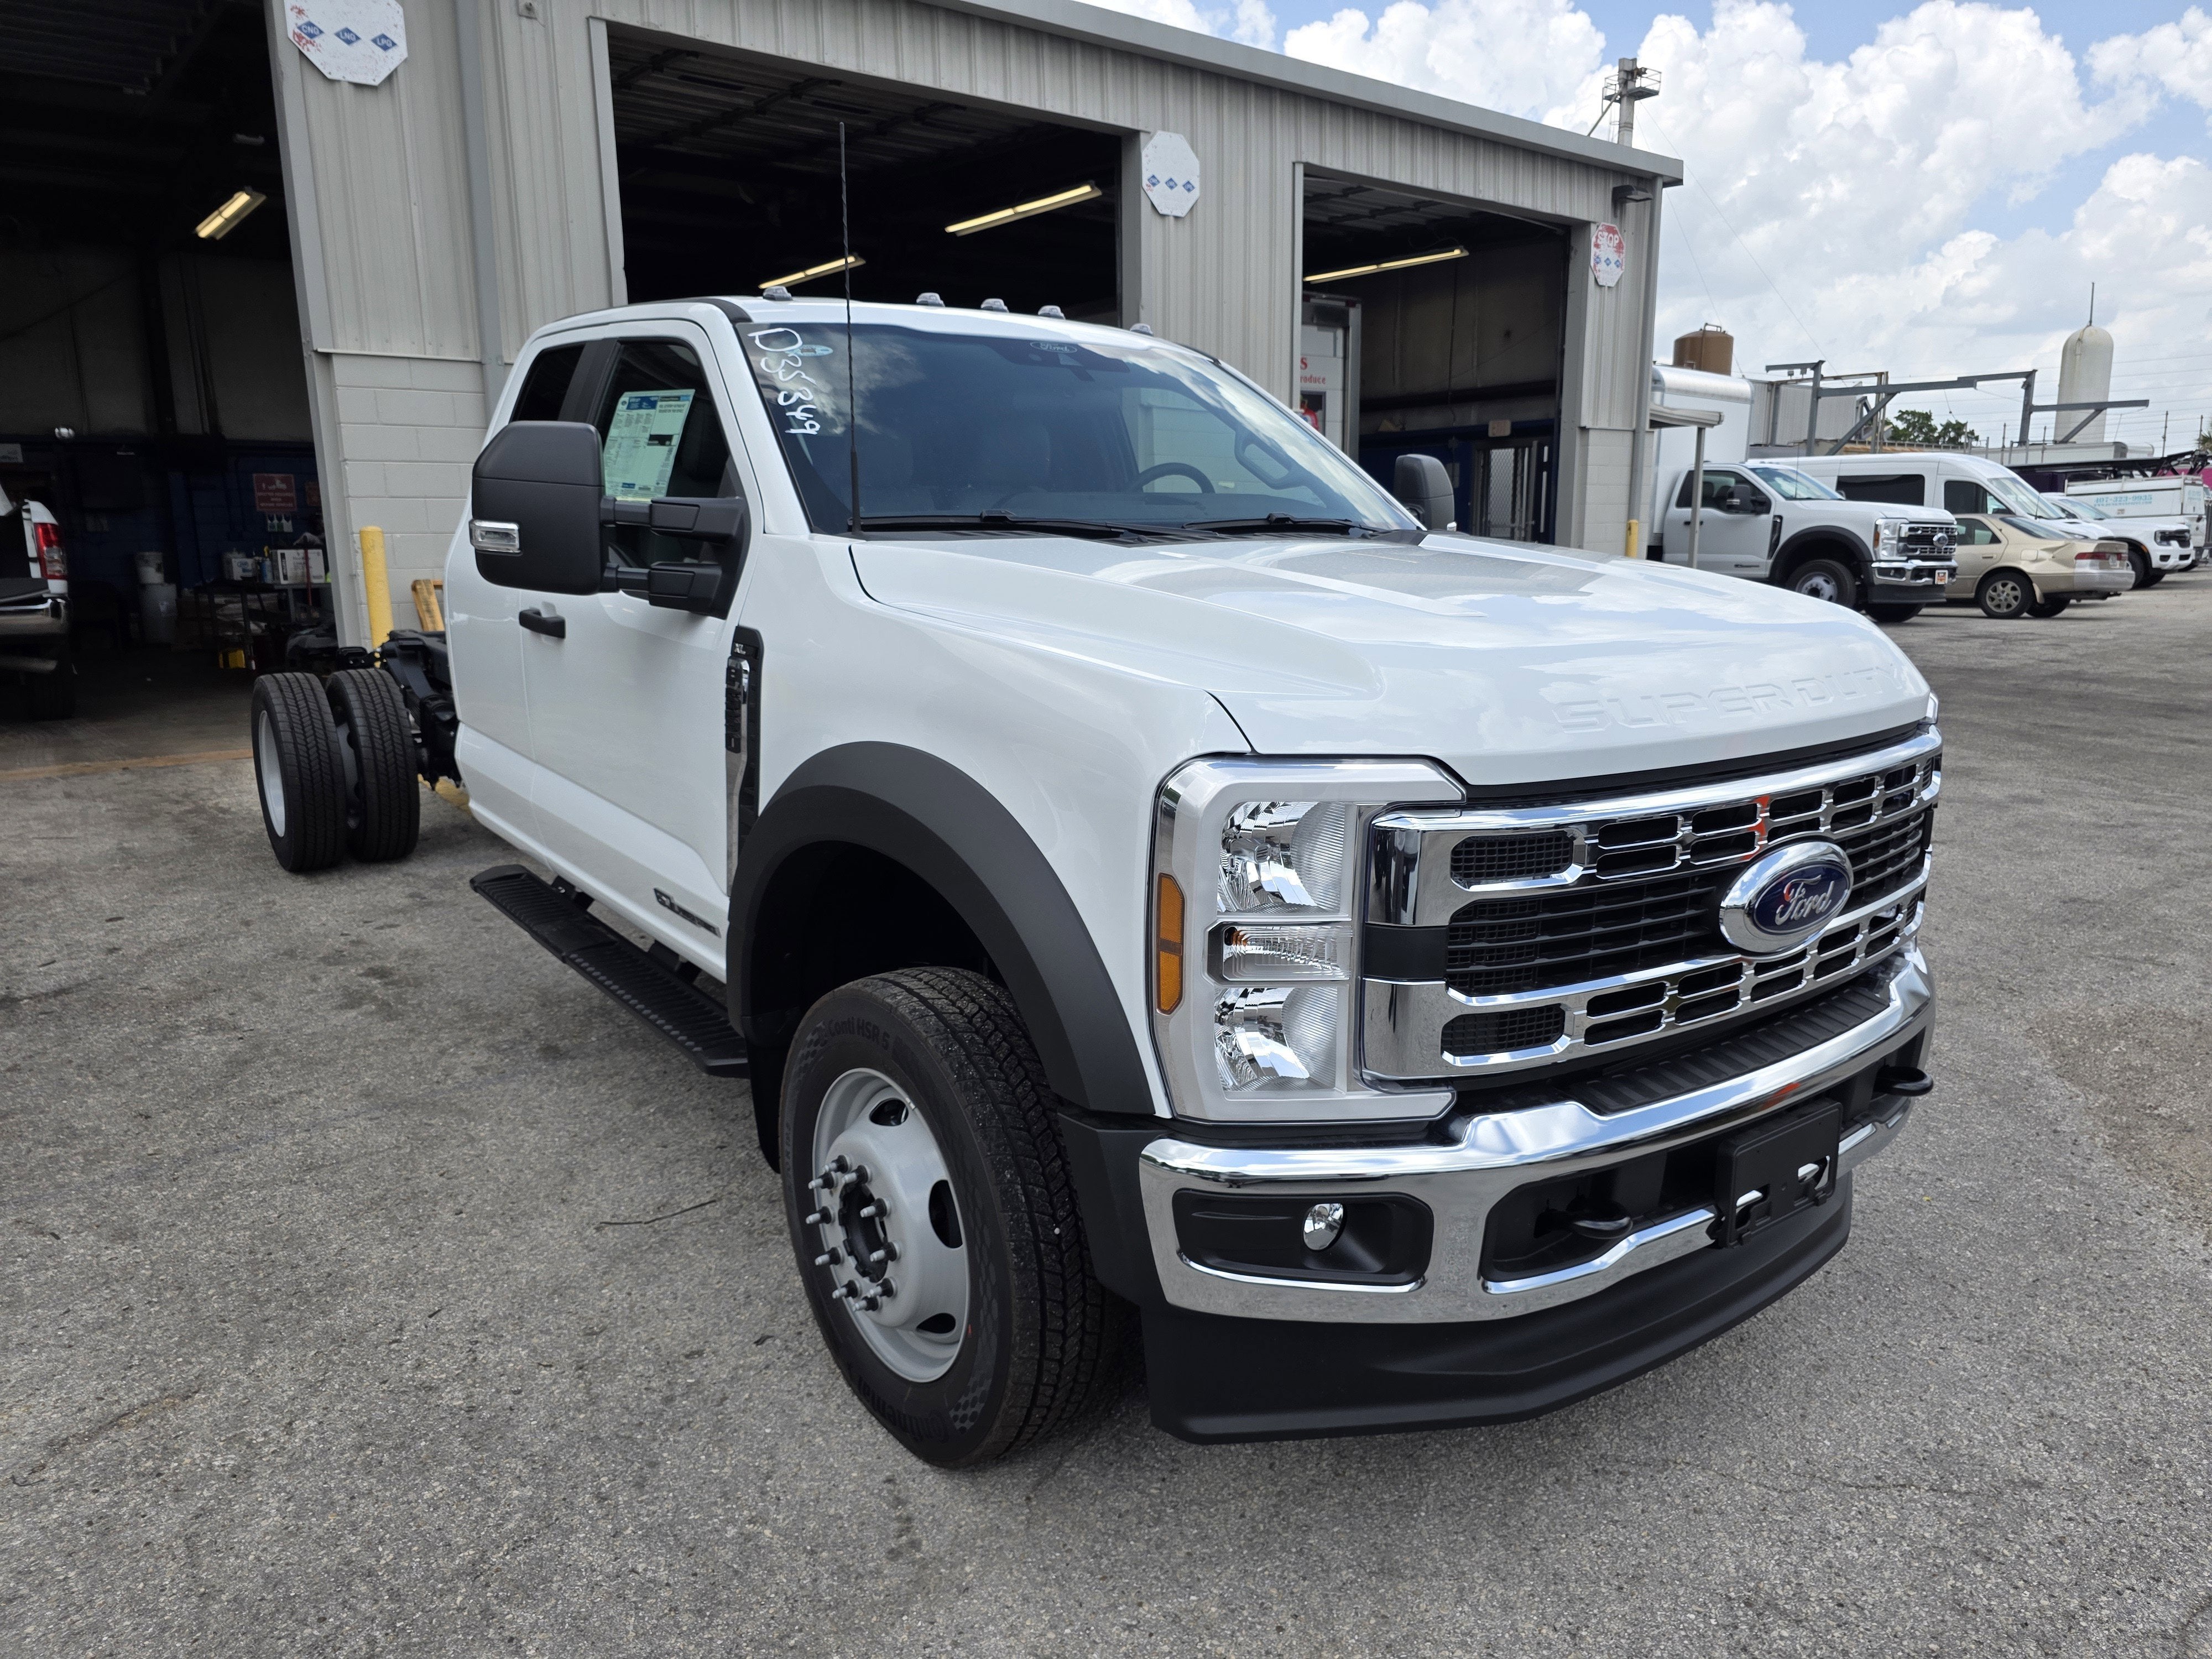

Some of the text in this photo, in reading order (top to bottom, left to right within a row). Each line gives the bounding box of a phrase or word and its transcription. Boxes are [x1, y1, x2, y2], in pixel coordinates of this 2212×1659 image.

[1040, 342, 1070, 352] Ford
[1301, 375, 1326, 384] roduce
[734, 643, 746, 655] XL
[1551, 664, 1903, 734] SUPER DUTY
[1775, 874, 1835, 926] Ford
